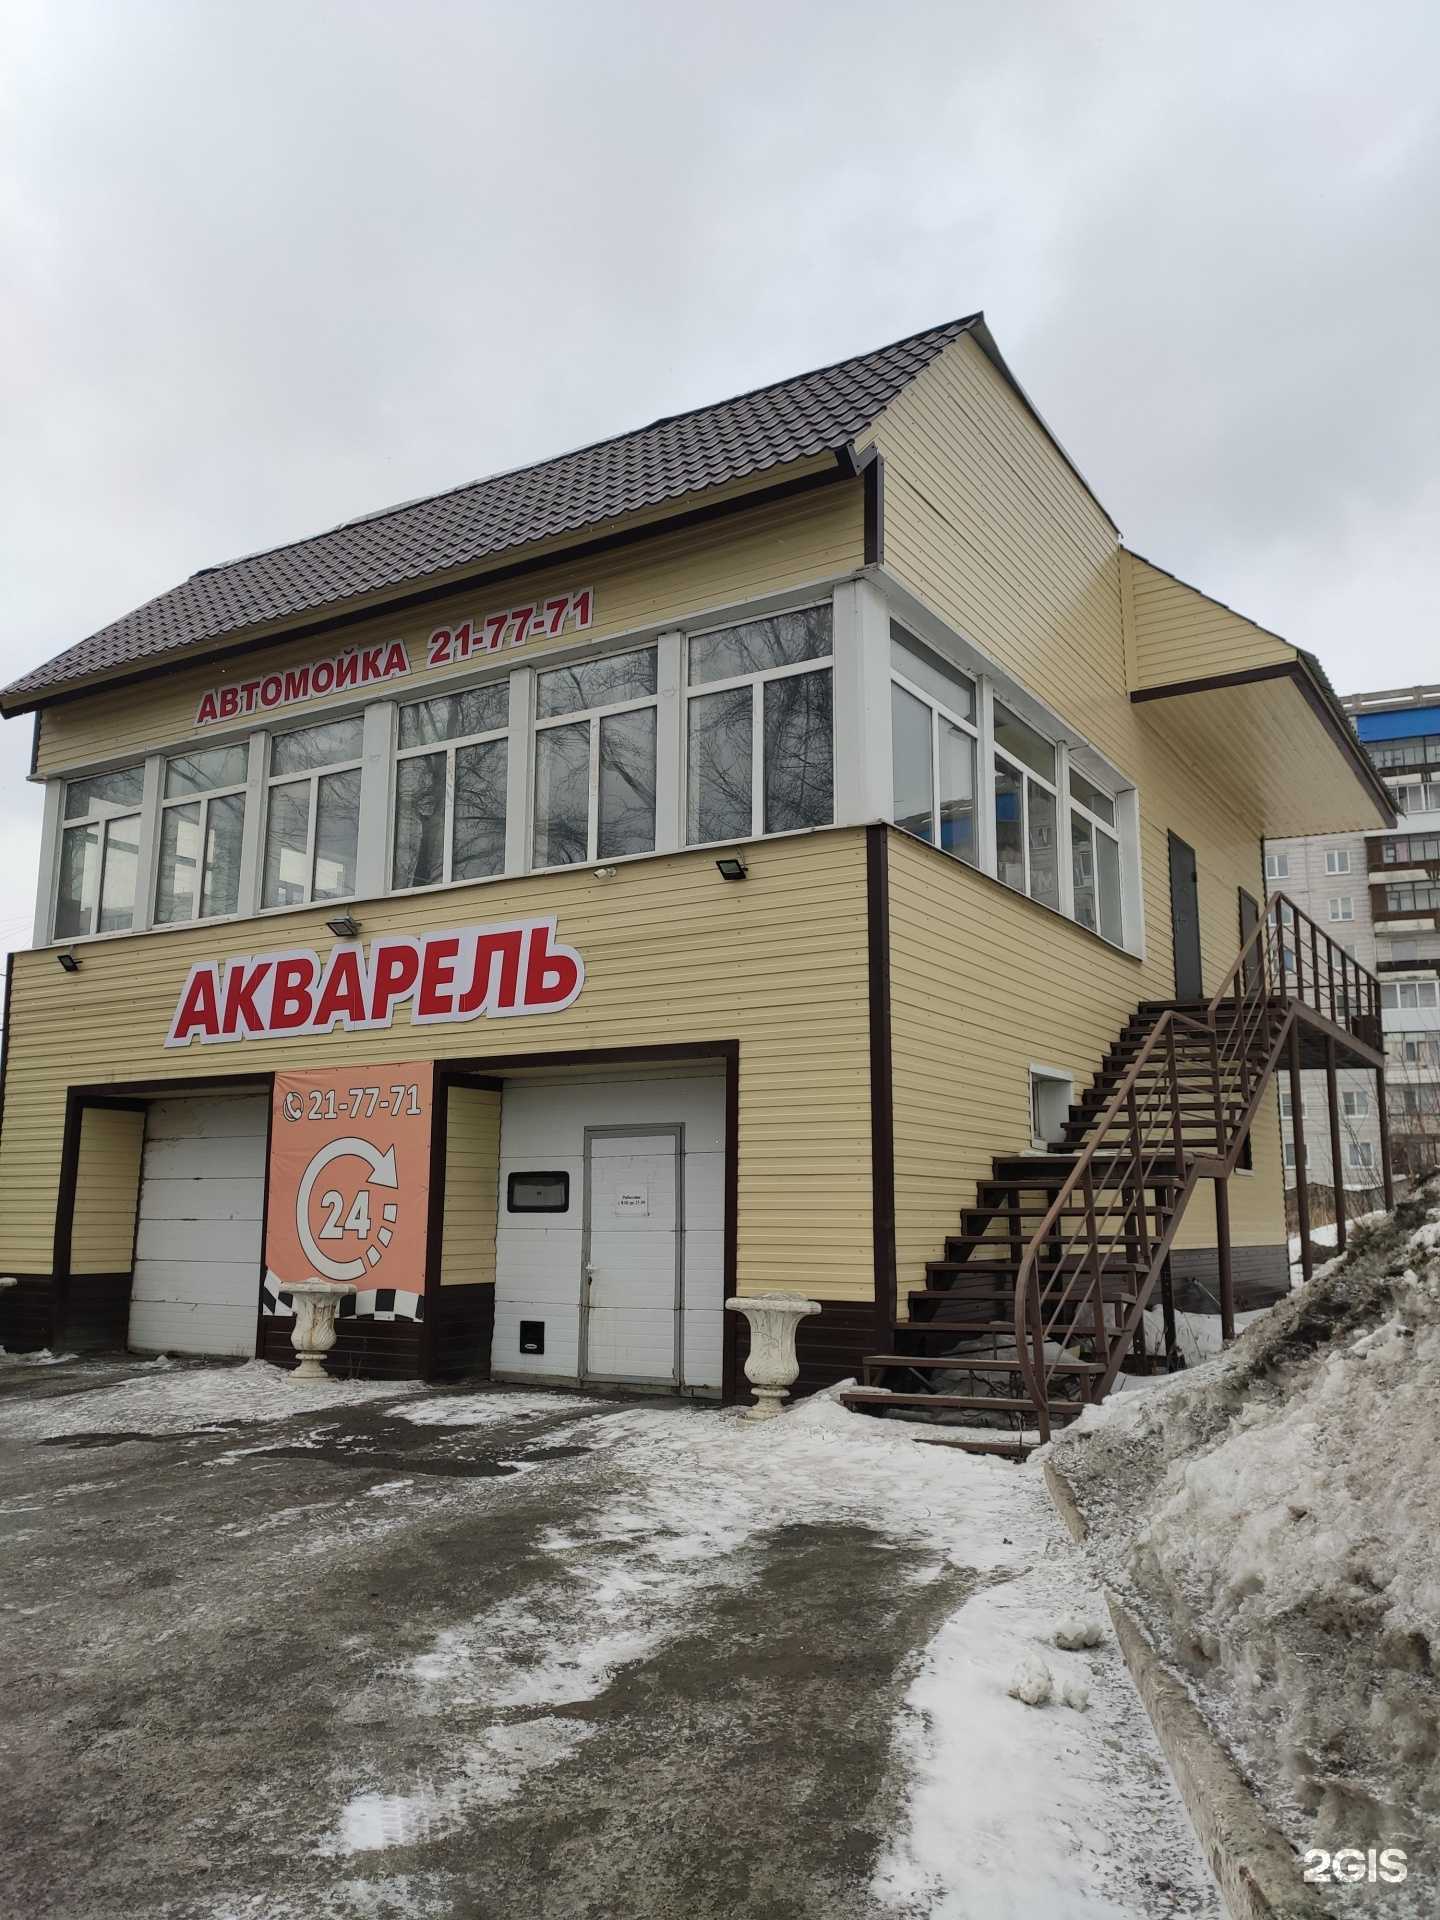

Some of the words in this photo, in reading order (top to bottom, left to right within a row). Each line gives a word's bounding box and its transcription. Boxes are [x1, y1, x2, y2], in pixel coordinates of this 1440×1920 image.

[196, 642, 408, 724] АВТОМОЙКА
[429, 591, 592, 665] 21-77-71
[172, 926, 578, 1039] АКВАРЕЛЬ
[308, 1084, 421, 1120] 21-77-71
[318, 1190, 371, 1240] 24
